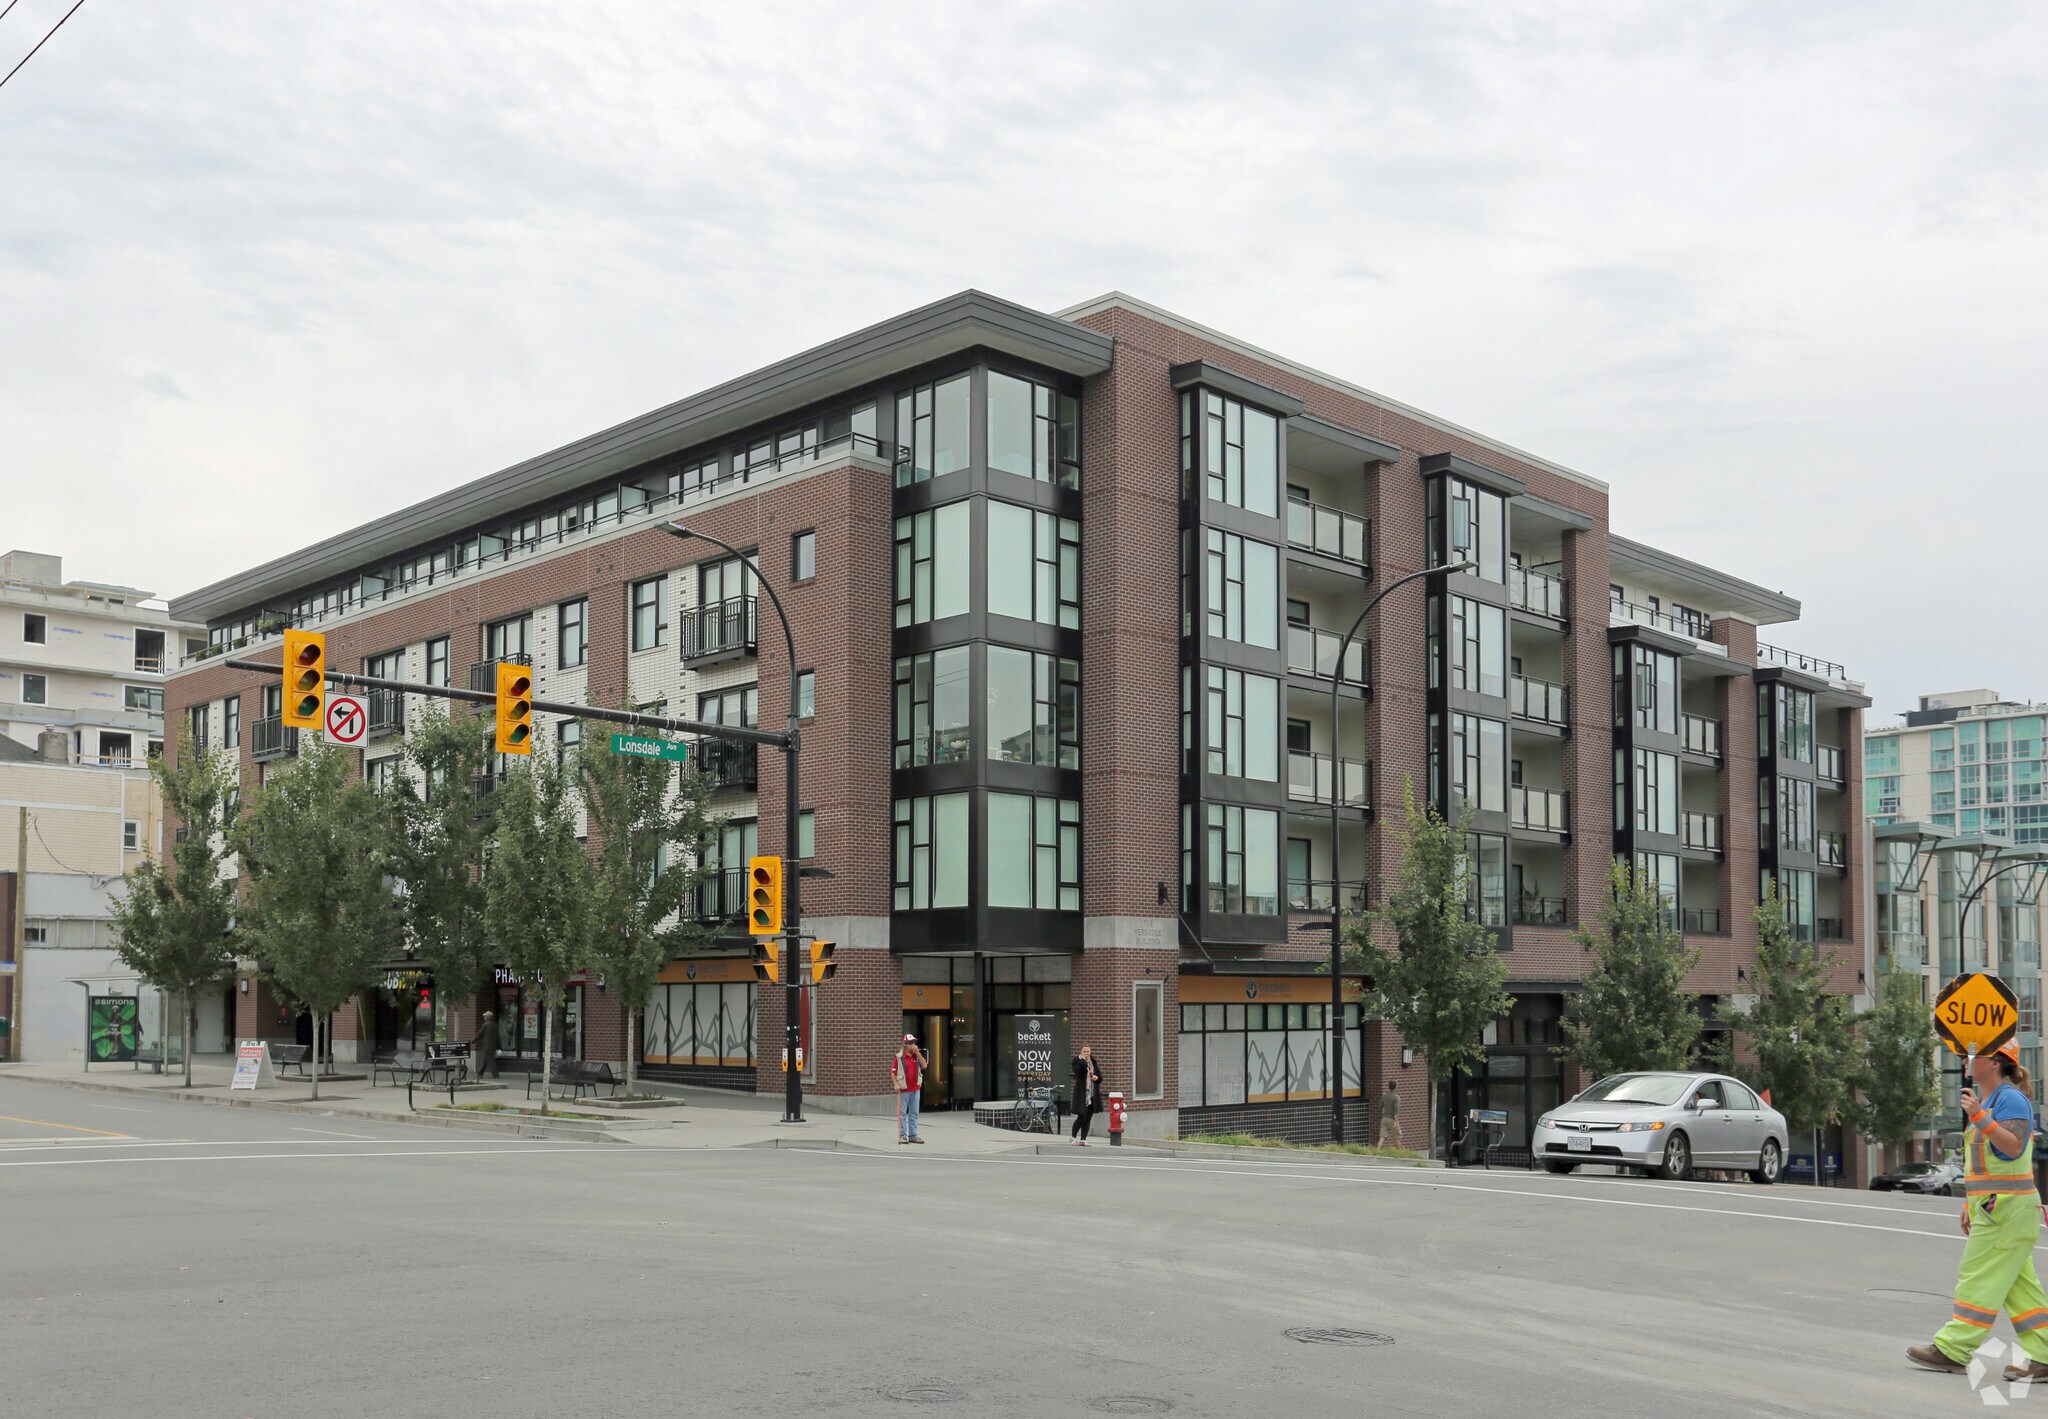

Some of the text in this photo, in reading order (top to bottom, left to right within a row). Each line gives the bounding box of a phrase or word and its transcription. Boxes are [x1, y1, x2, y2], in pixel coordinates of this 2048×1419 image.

[619, 737, 677, 755] Lonsdale Ave
[1946, 1001, 2007, 1027] SLOW
[1018, 1032, 1051, 1041] beckett
[1018, 1050, 1051, 1061] NOW
[1018, 1061, 1051, 1071] OPEN
